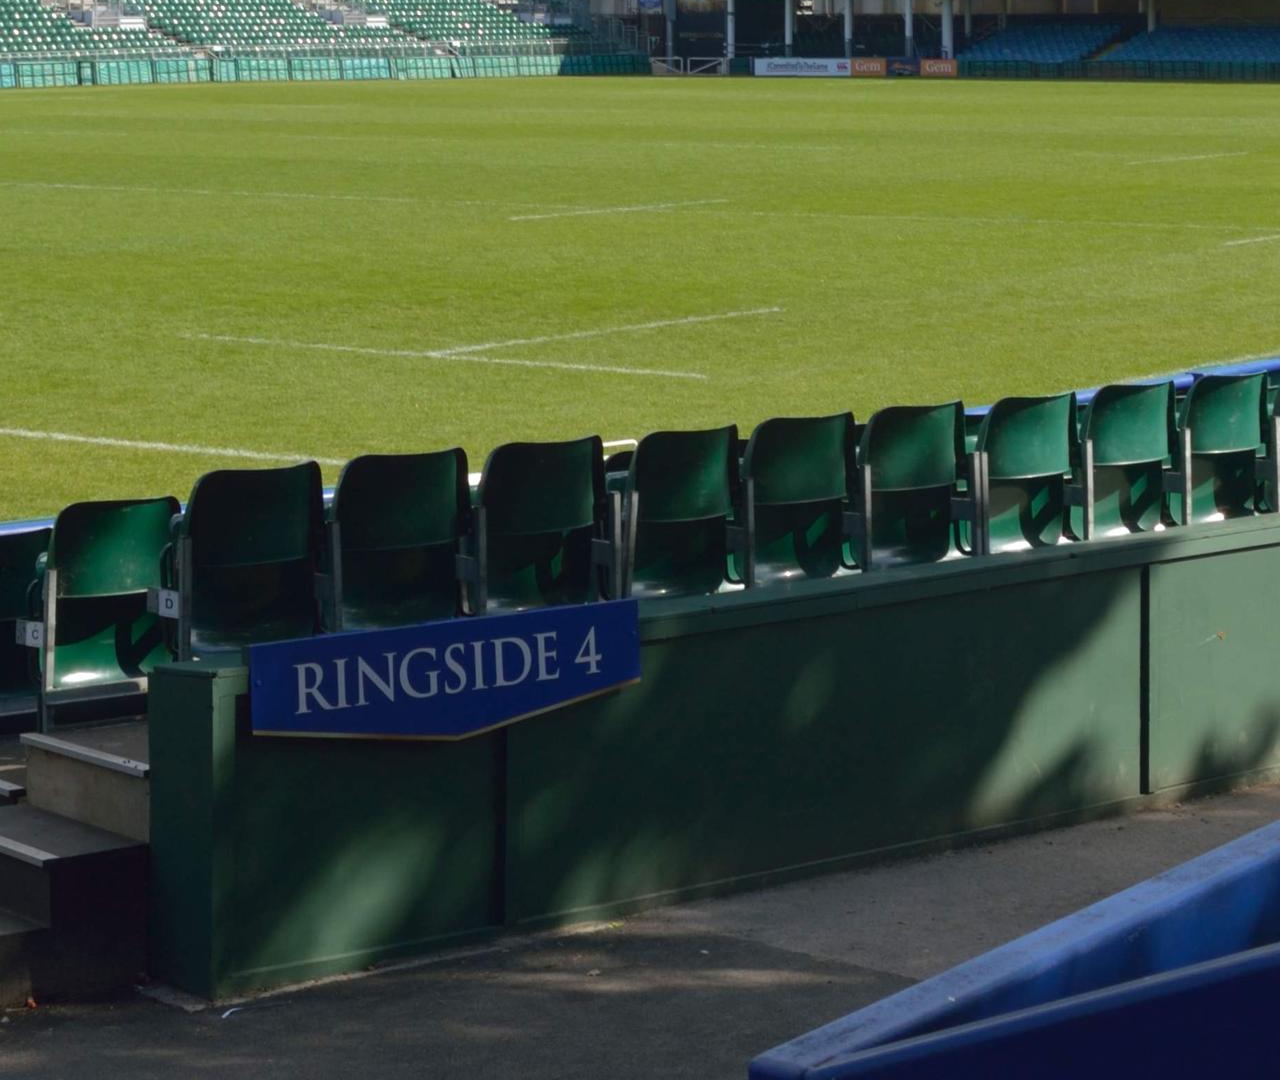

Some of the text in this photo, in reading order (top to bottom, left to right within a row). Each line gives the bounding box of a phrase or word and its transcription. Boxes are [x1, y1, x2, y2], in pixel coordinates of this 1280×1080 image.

[855, 61, 881, 72] Gem
[926, 62, 952, 73] Gem
[165, 598, 173, 609] D
[31, 629, 40, 640] C
[293, 625, 602, 715] RINGSIDE 4
